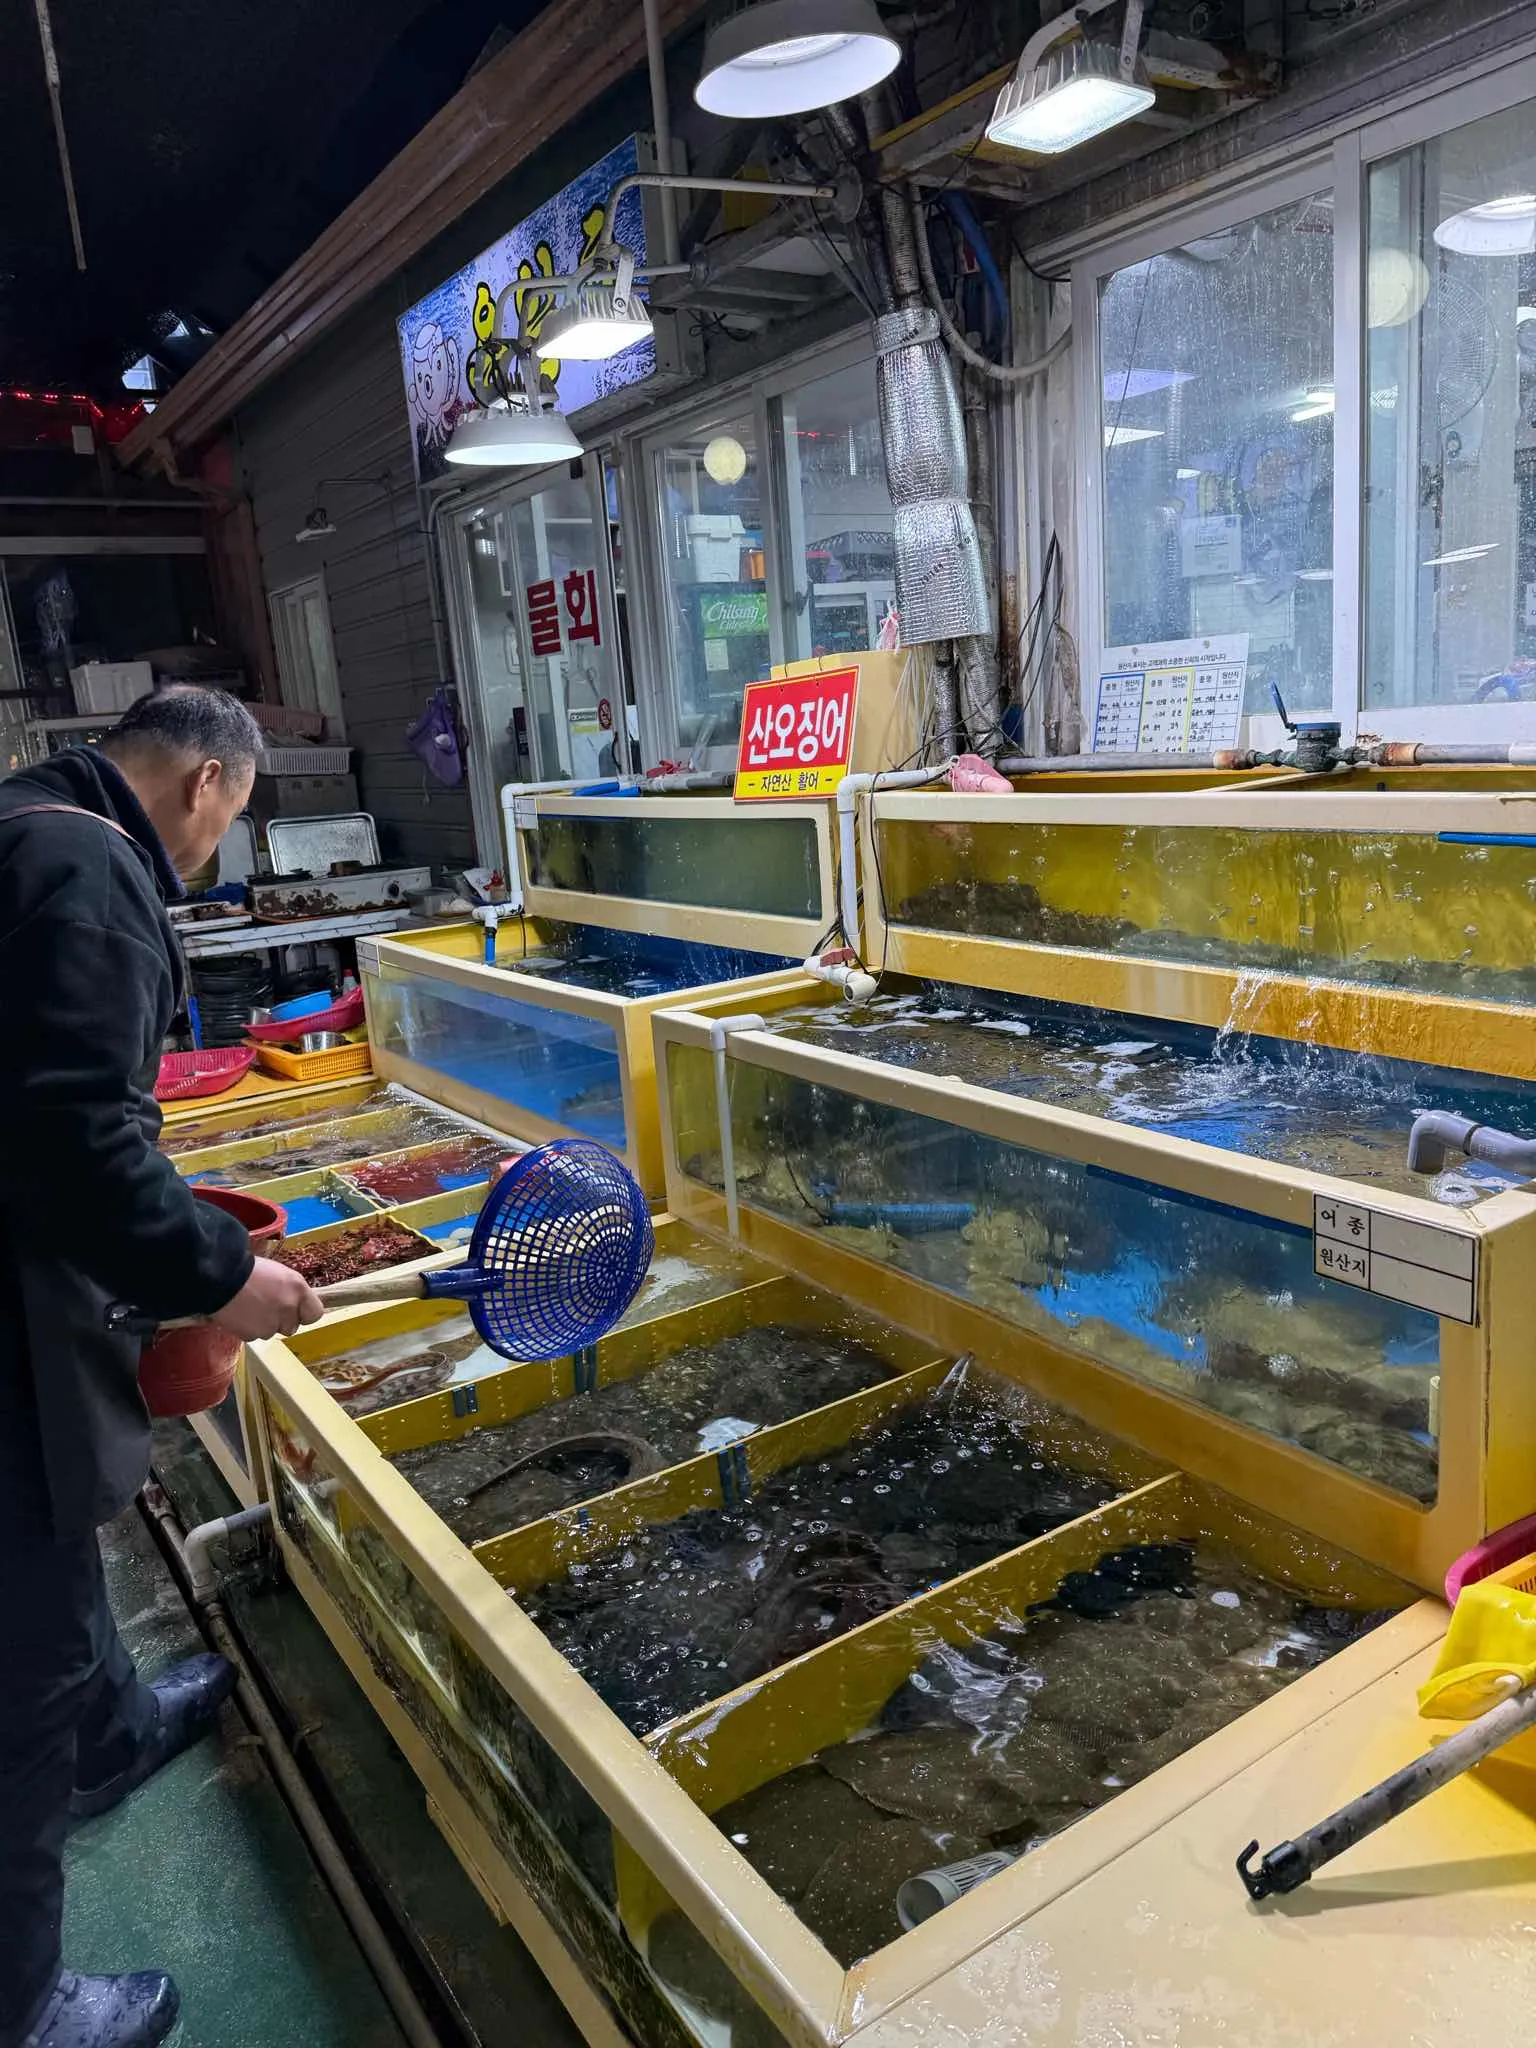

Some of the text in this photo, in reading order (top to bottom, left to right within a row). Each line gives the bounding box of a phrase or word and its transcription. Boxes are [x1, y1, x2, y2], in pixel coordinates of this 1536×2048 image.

[527, 569, 601, 656] 물회
[748, 693, 849, 765] 산오징어
[761, 772, 819, 792] 자연산 활어
[1320, 1248, 1366, 1279] 원산지
